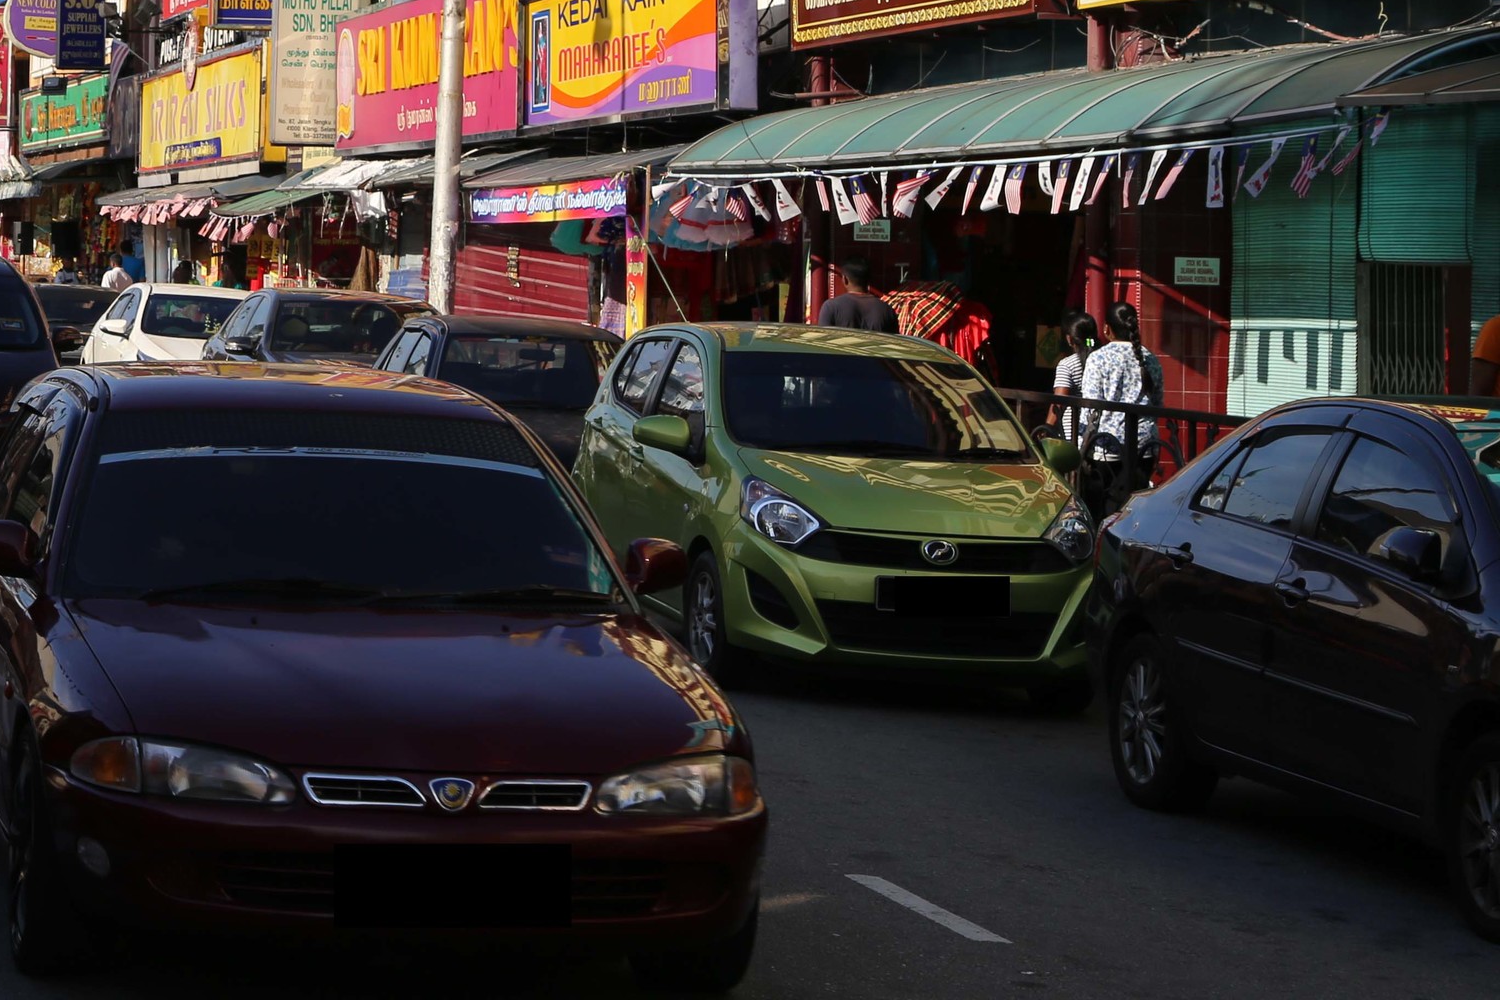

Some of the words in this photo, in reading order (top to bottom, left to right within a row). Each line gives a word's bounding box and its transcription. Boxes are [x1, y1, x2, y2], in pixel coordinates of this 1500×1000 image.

[62, 24, 102, 36] JEWELLERS
[68, 12, 97, 23] SUPPIAH
[292, 13, 316, 32] SDN.
[357, 25, 388, 97] SRI
[558, 19, 667, 83] MAHARANEE'S
[205, 79, 247, 133] SILKS
